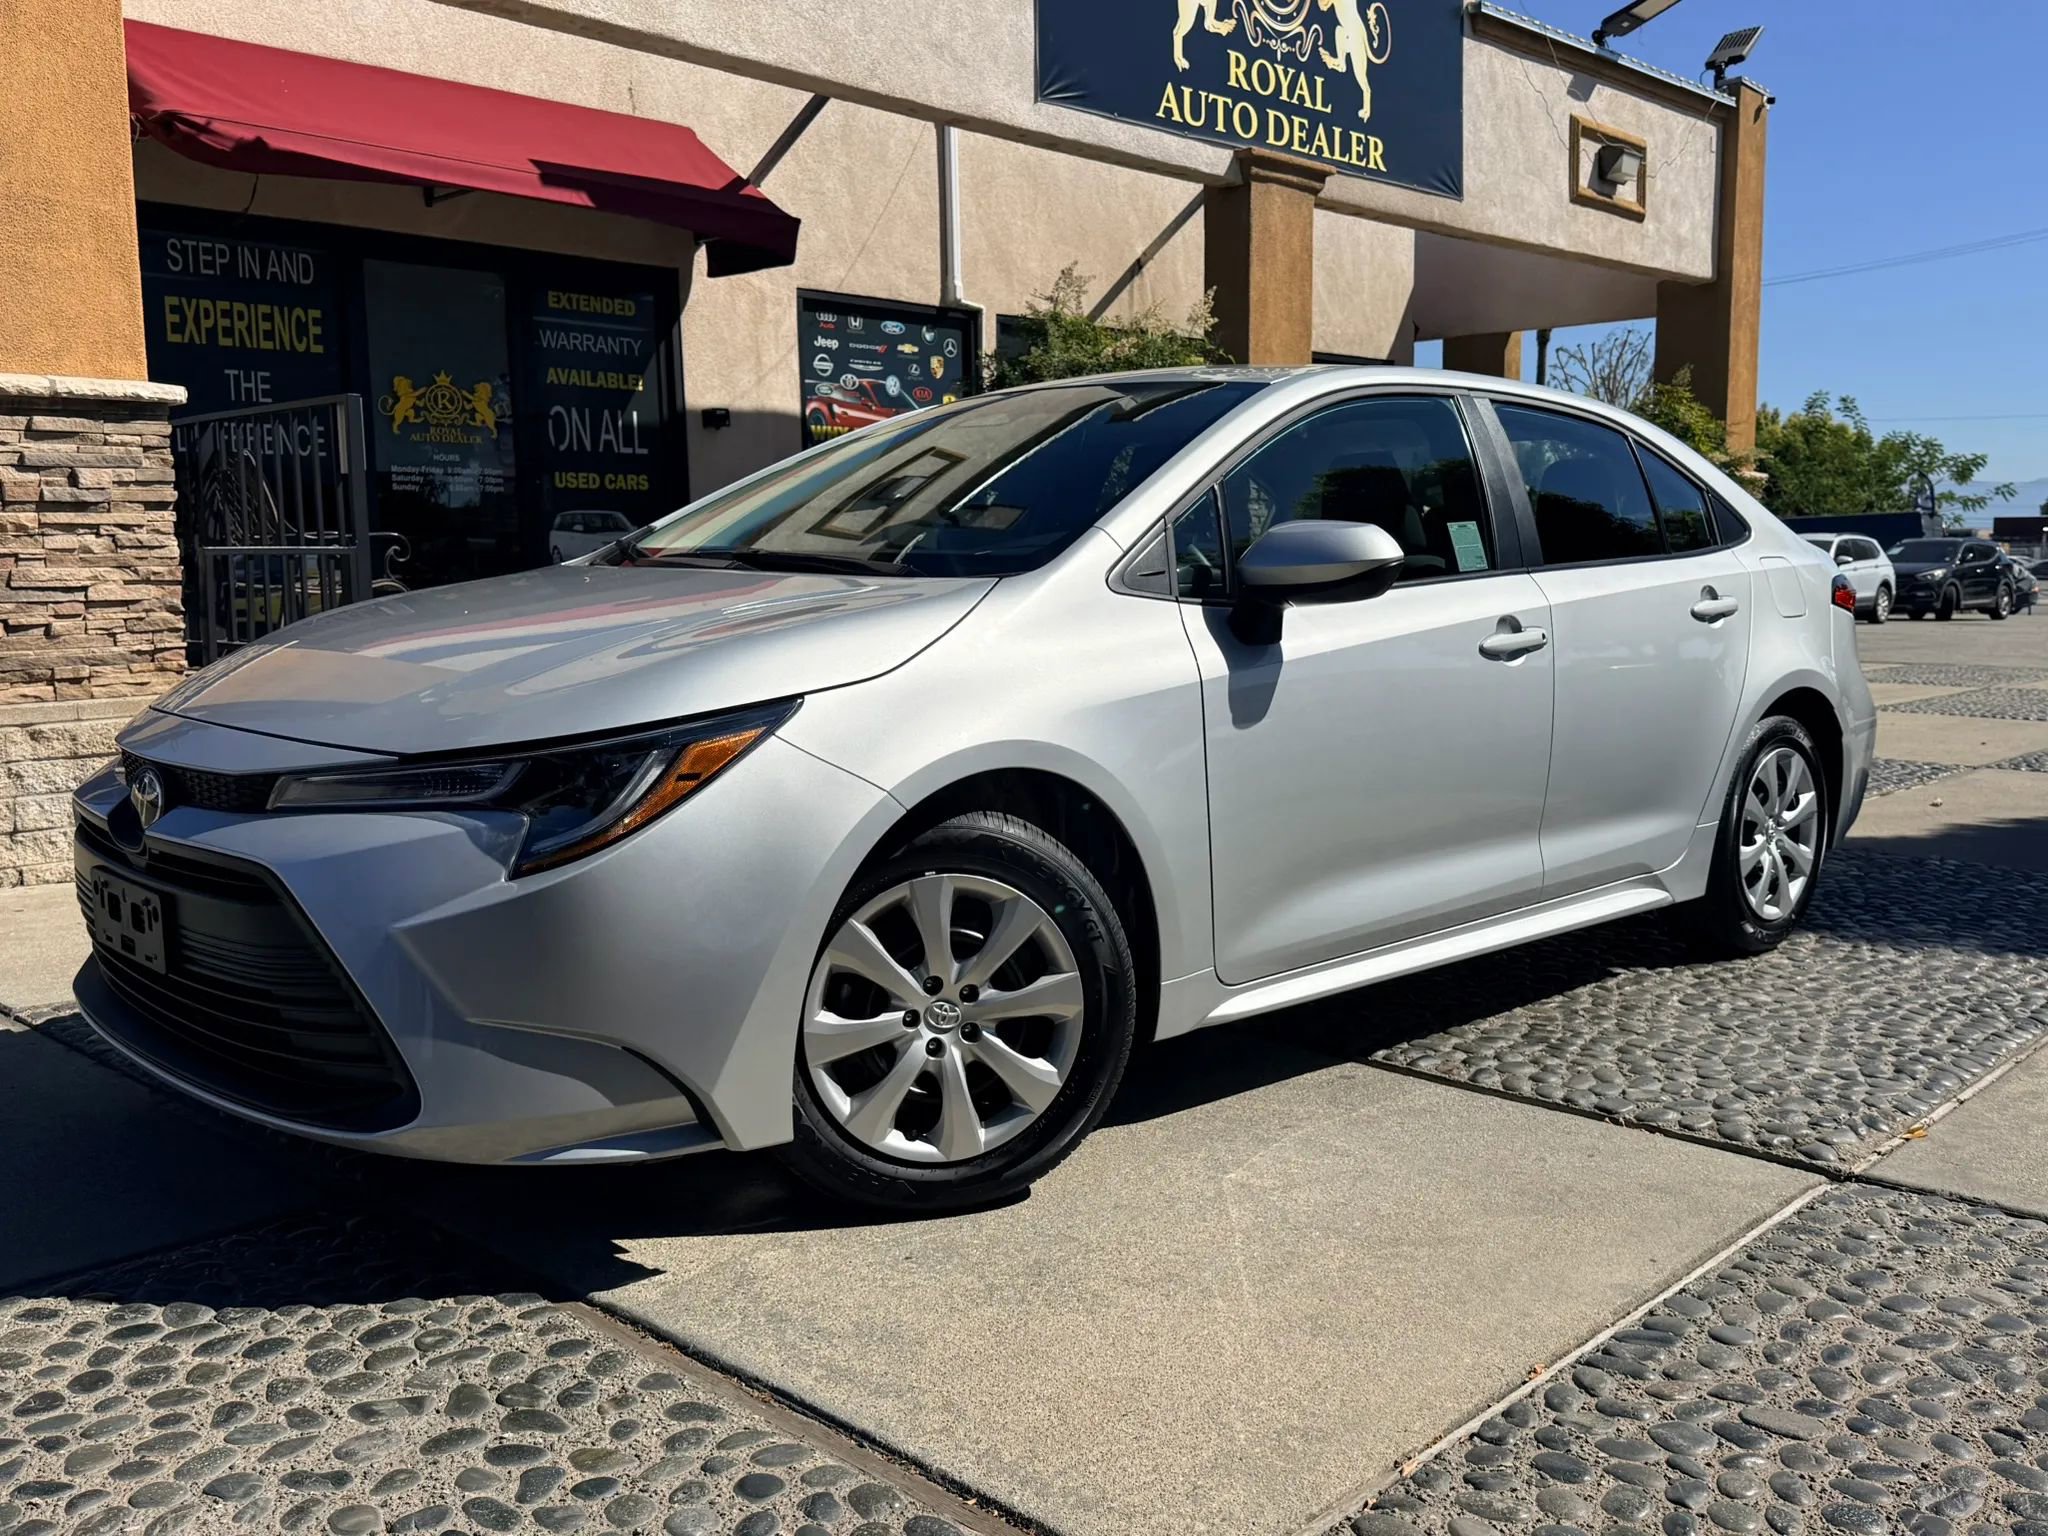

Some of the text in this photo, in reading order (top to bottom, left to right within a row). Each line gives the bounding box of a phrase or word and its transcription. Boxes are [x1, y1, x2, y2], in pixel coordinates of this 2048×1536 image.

[1227, 49, 1332, 114] ROYAL
[1156, 81, 1387, 172] AUTO DEALER
[166, 238, 314, 285] STEP IN AND
[547, 289, 636, 317] EXTENDED
[164, 295, 325, 354] EXPERIENCE
[539, 328, 643, 357] WARRANTY
[814, 336, 839, 351] Jeep
[224, 368, 272, 403] THE
[546, 367, 644, 392] AVAILABLE!
[437, 391, 452, 409] R
[410, 433, 482, 444] AUTO DEALER
[430, 426, 461, 436] ROYAL
[548, 405, 649, 455] ON ALL
[433, 453, 461, 462] HOURS
[391, 473, 424, 484] Saturday
[392, 482, 420, 493] Sunday
[554, 471, 649, 491] USED CARS
